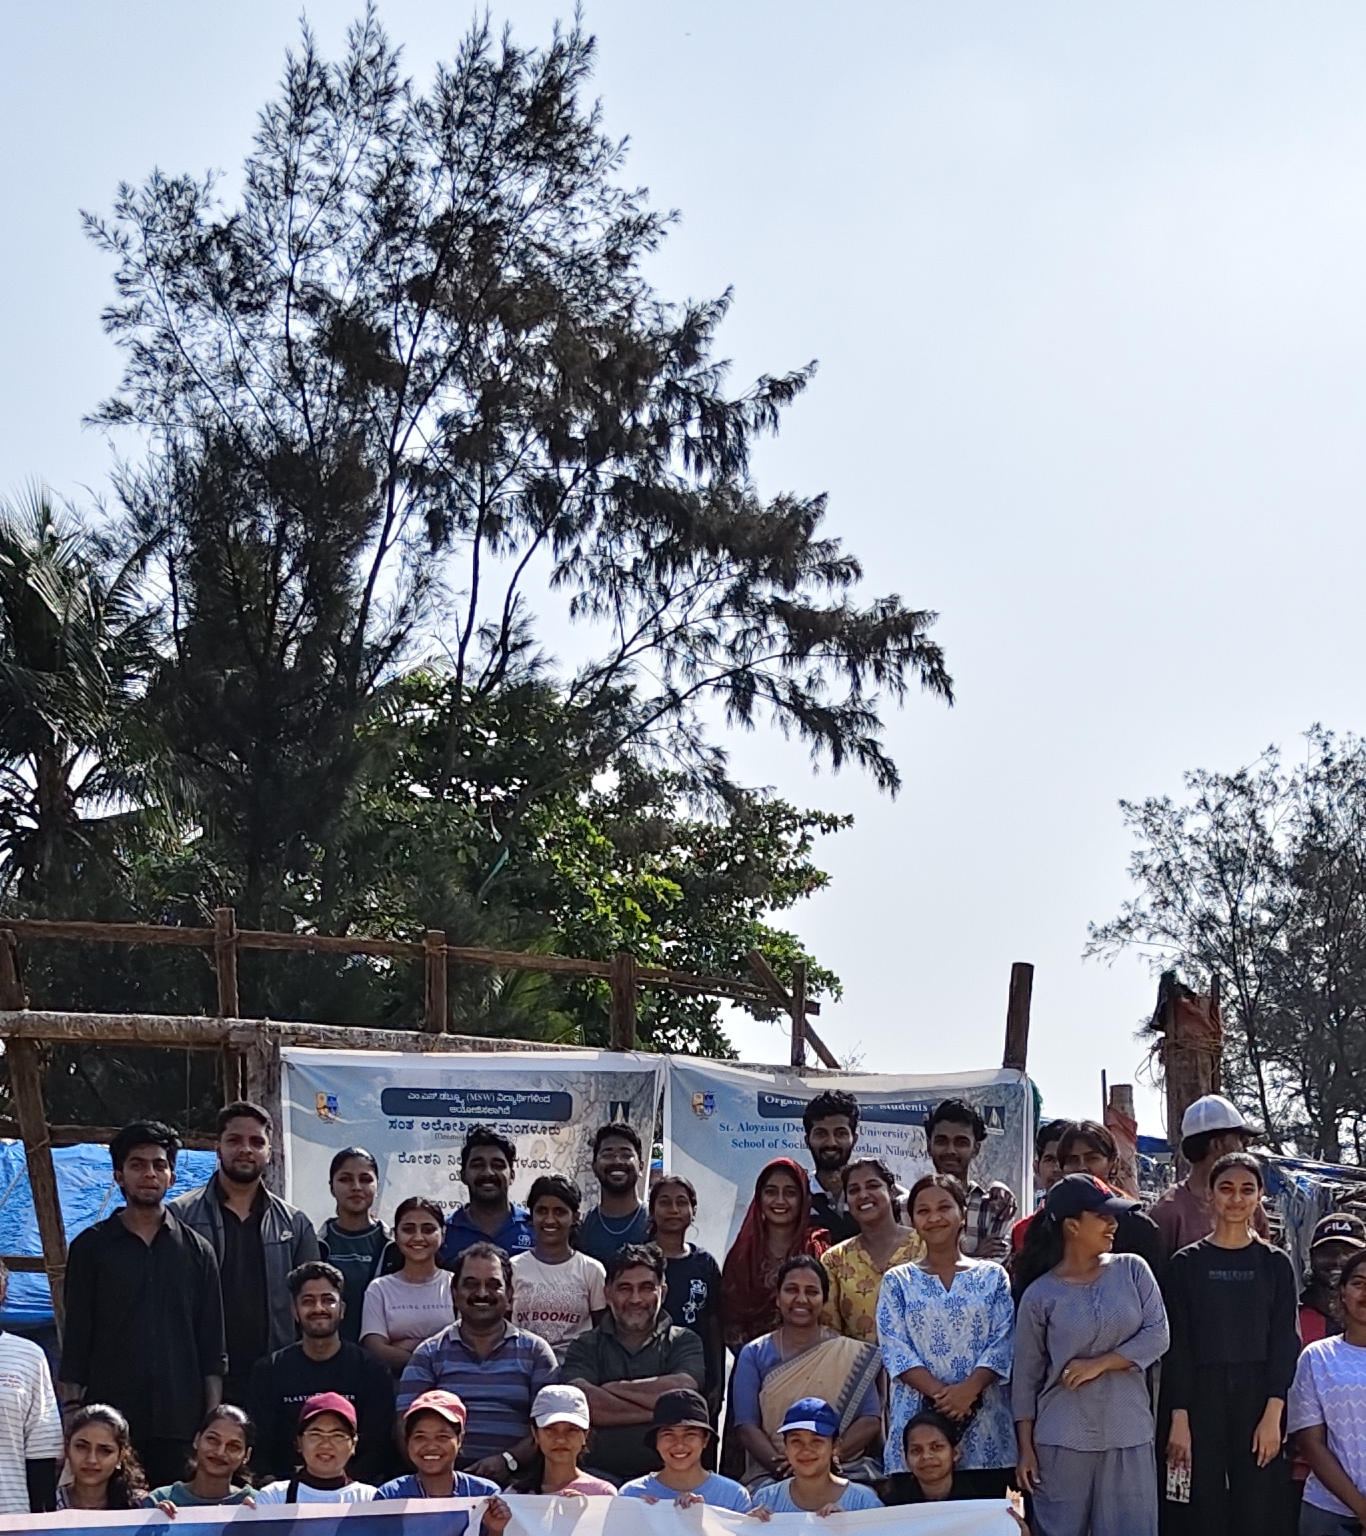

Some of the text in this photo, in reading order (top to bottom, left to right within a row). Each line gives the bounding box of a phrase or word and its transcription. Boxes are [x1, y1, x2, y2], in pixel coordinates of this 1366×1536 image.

[388, 1118, 415, 1130] ಸಂತ
[719, 1123, 734, 1132] St.
[737, 1122, 780, 1134] Aloysius
[859, 1126, 910, 1141] University
[731, 1139, 765, 1149] School
[768, 1138, 779, 1149] of
[1324, 1221, 1352, 1234] FILA
